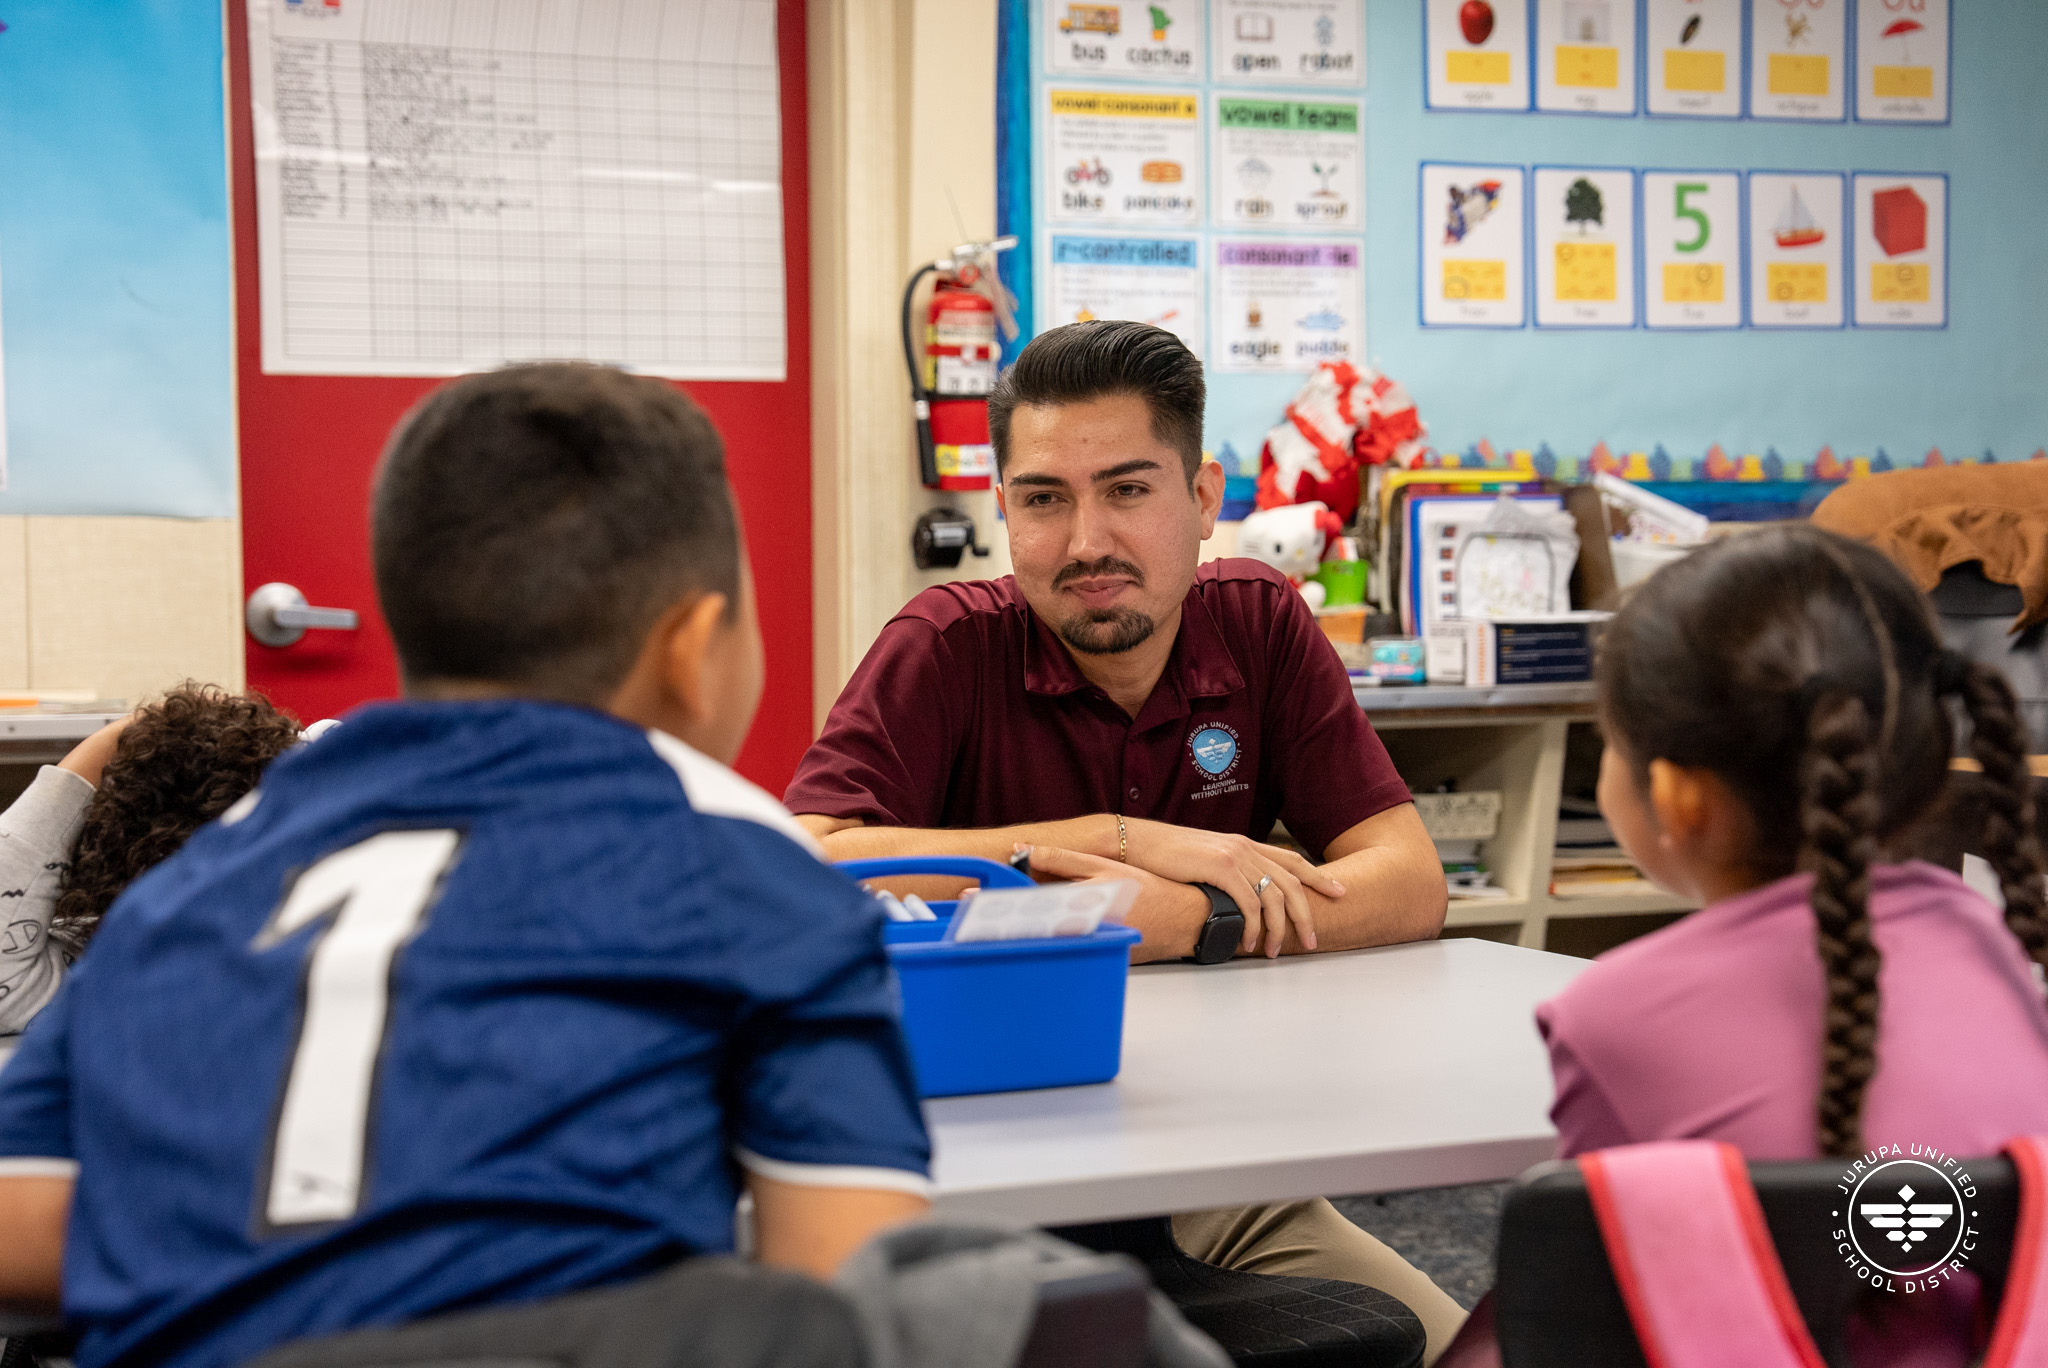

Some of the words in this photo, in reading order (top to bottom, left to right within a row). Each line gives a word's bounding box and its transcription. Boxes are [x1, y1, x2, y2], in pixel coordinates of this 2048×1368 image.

[1071, 43, 1107, 62] bus
[1126, 46, 1192, 66] cactus
[1300, 51, 1354, 71] robot
[1233, 53, 1280, 73] open
[1222, 103, 1290, 124] vowel
[1297, 105, 1355, 128] team
[1062, 191, 1104, 210] bike
[1234, 196, 1274, 215] rain
[1296, 200, 1348, 219] sprout
[1675, 183, 1710, 252] 5
[1056, 241, 1193, 263] r-controlled
[1224, 247, 1320, 265] consonant
[1230, 341, 1281, 361] eagle
[1296, 340, 1350, 357] puddle
[1187, 723, 1209, 748] JURUPA
[1210, 721, 1239, 740] UNIFIED
[1191, 759, 1218, 781] SCHOOL
[1218, 748, 1242, 780] DISTRICT
[1191, 788, 1223, 800] WITHOUT
[1223, 783, 1249, 793] LIMITS
[1202, 778, 1236, 791] LEARNING
[248, 827, 462, 1230] 1
